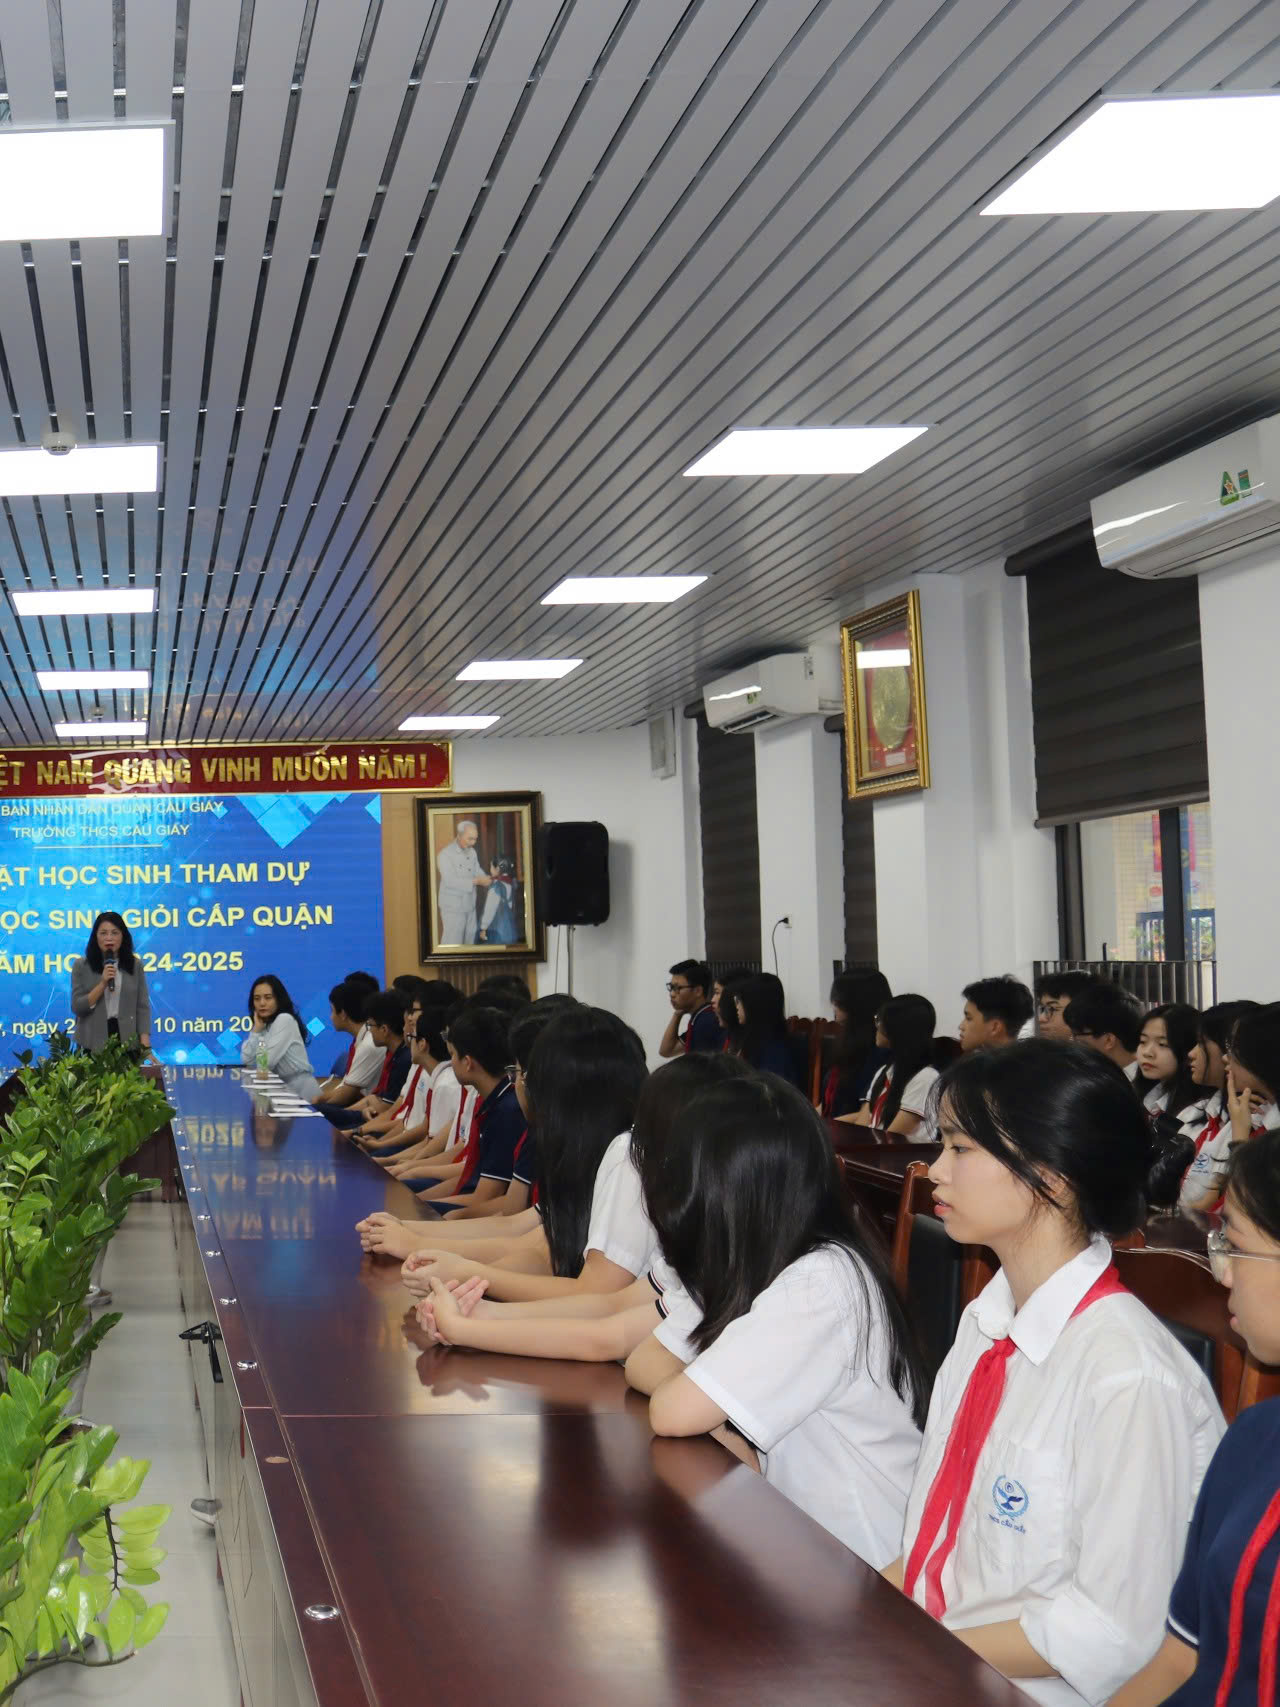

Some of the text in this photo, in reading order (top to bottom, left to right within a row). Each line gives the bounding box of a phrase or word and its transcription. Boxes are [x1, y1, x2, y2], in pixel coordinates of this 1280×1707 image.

[37, 758, 93, 786] NAM
[104, 757, 192, 790] QUANG
[201, 757, 261, 783] VINH
[1, 805, 30, 817] BAN
[33, 803, 74, 816] NHÂN
[13, 824, 76, 838] TRƯỜNG
[80, 826, 118, 838] THCS
[38, 865, 98, 890] HỌC
[106, 864, 171, 885] SINH
[179, 862, 258, 883] THAM
[267, 861, 310, 886] DỰ
[48, 909, 112, 930] SIN
[121, 904, 179, 928] GIỎI
[187, 902, 245, 927] CẤP
[252, 902, 333, 930] QUẬN
[132, 951, 244, 972] 24-2025
[12, 1018, 58, 1038] ngày
[153, 1017, 176, 1033] 10
[182, 1016, 223, 1033] năm
[229, 1015, 254, 1033] 20
